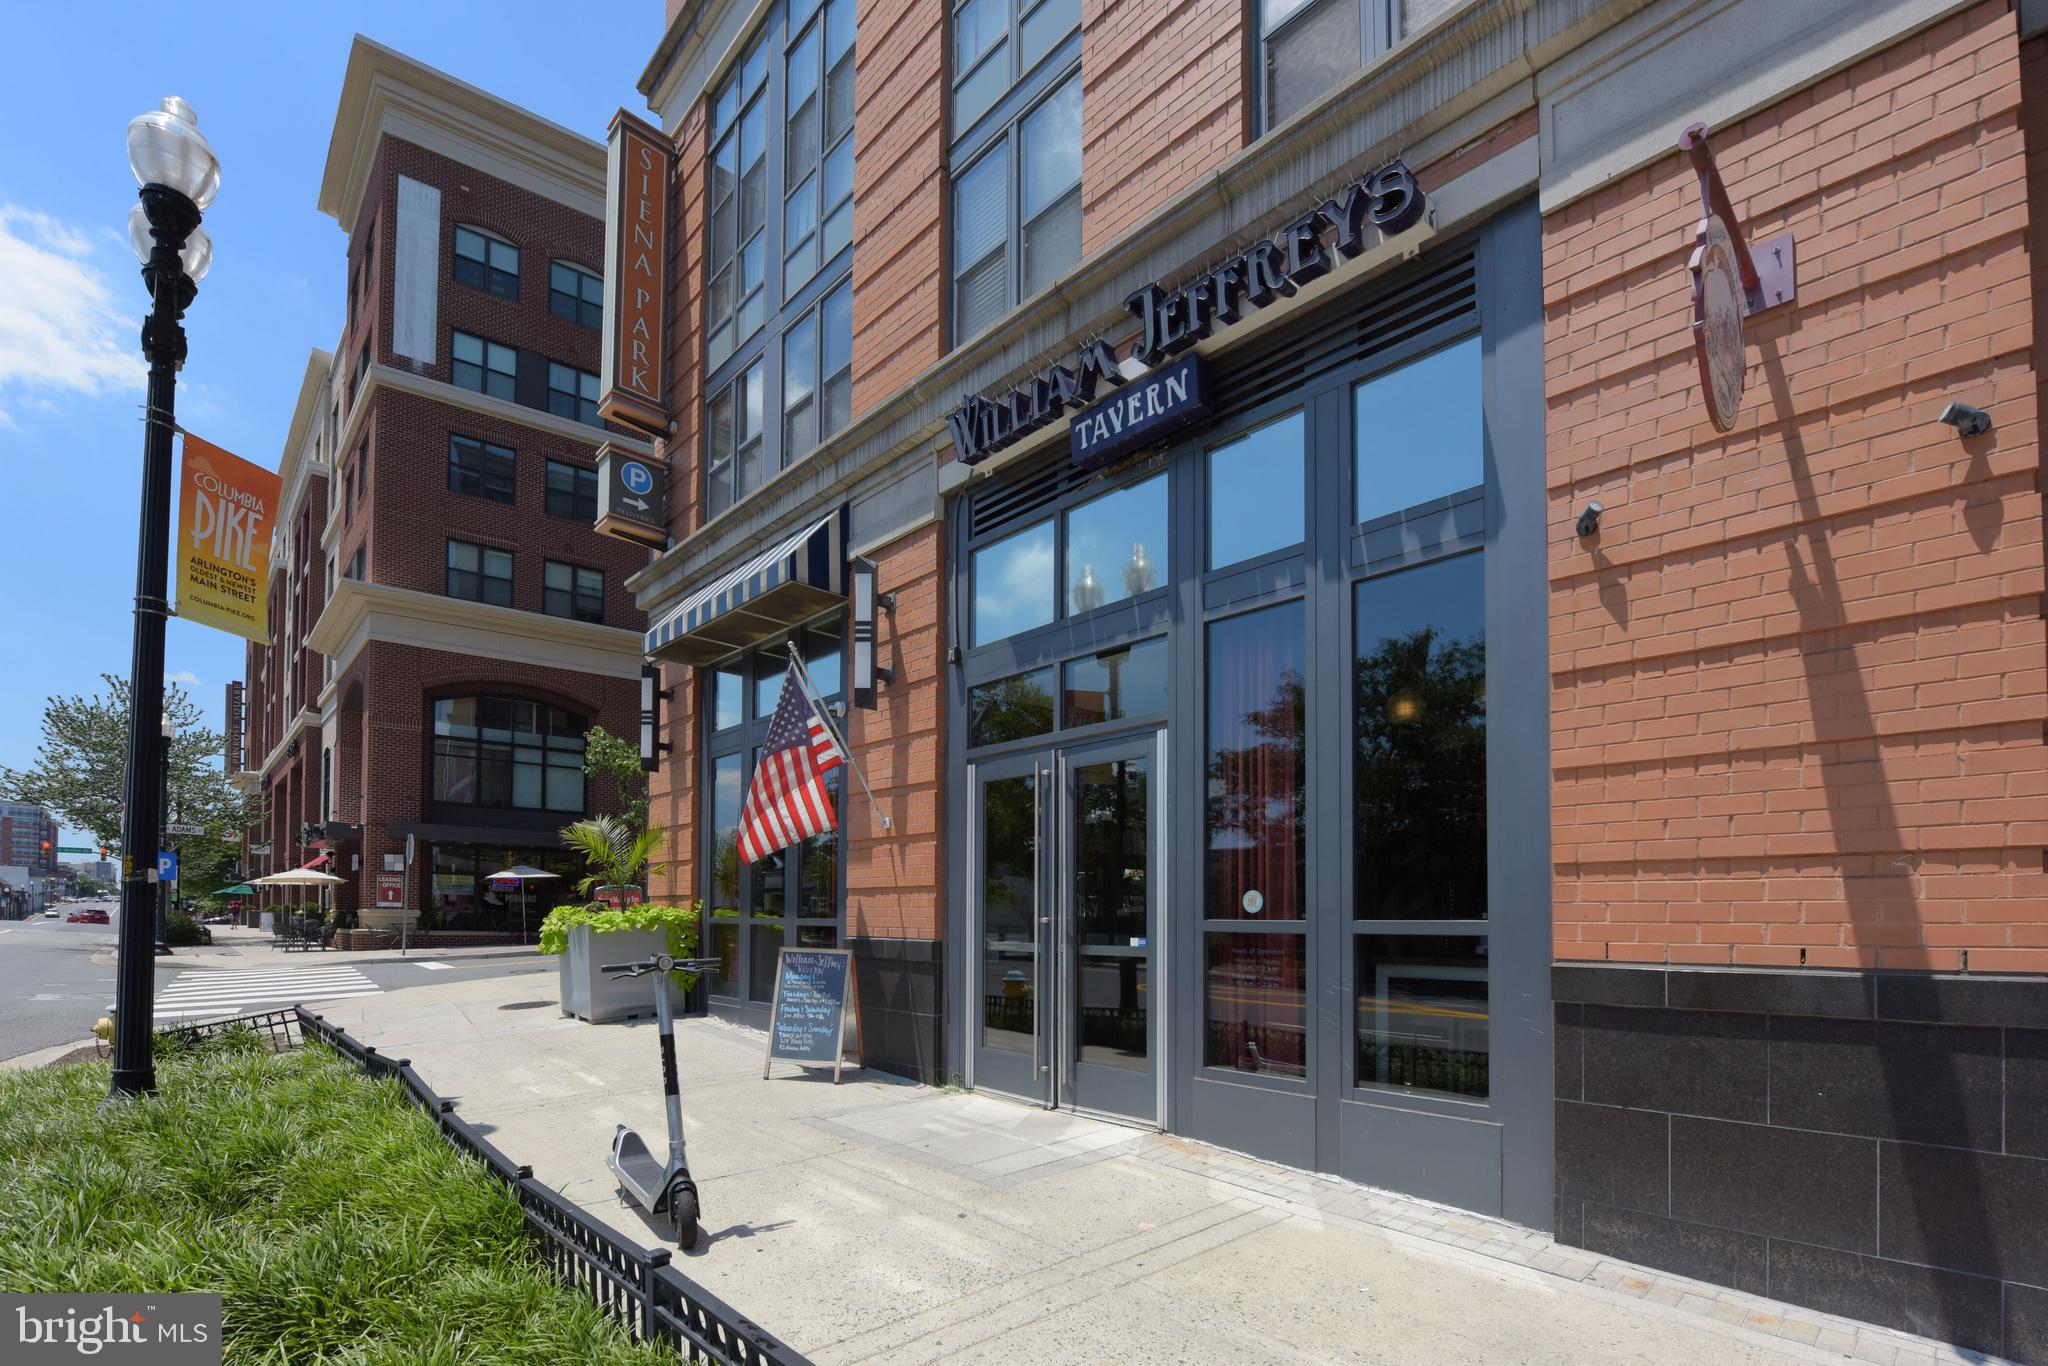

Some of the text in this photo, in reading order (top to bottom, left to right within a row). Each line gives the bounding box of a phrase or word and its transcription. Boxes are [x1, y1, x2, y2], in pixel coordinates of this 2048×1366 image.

[632, 148, 654, 393] SIENA PARK
[946, 158, 1426, 465] WILLIAM JEFFREY'S
[1074, 367, 1188, 450] TAVERN
[193, 472, 264, 514] COLUMBIA
[630, 467, 647, 489] P
[190, 489, 264, 573] PIKE
[190, 555, 256, 587] ARLINGTON'S
[190, 565, 217, 583] OLDEST
[226, 579, 256, 595] NEWEST
[190, 574, 256, 604] MAIN STREET
[189, 594, 256, 622] COLUMBIA-PIKE.ORG
[232, 683, 241, 720] SQUARE
[172, 825, 196, 834] ADAMS
[159, 858, 172, 875] P
